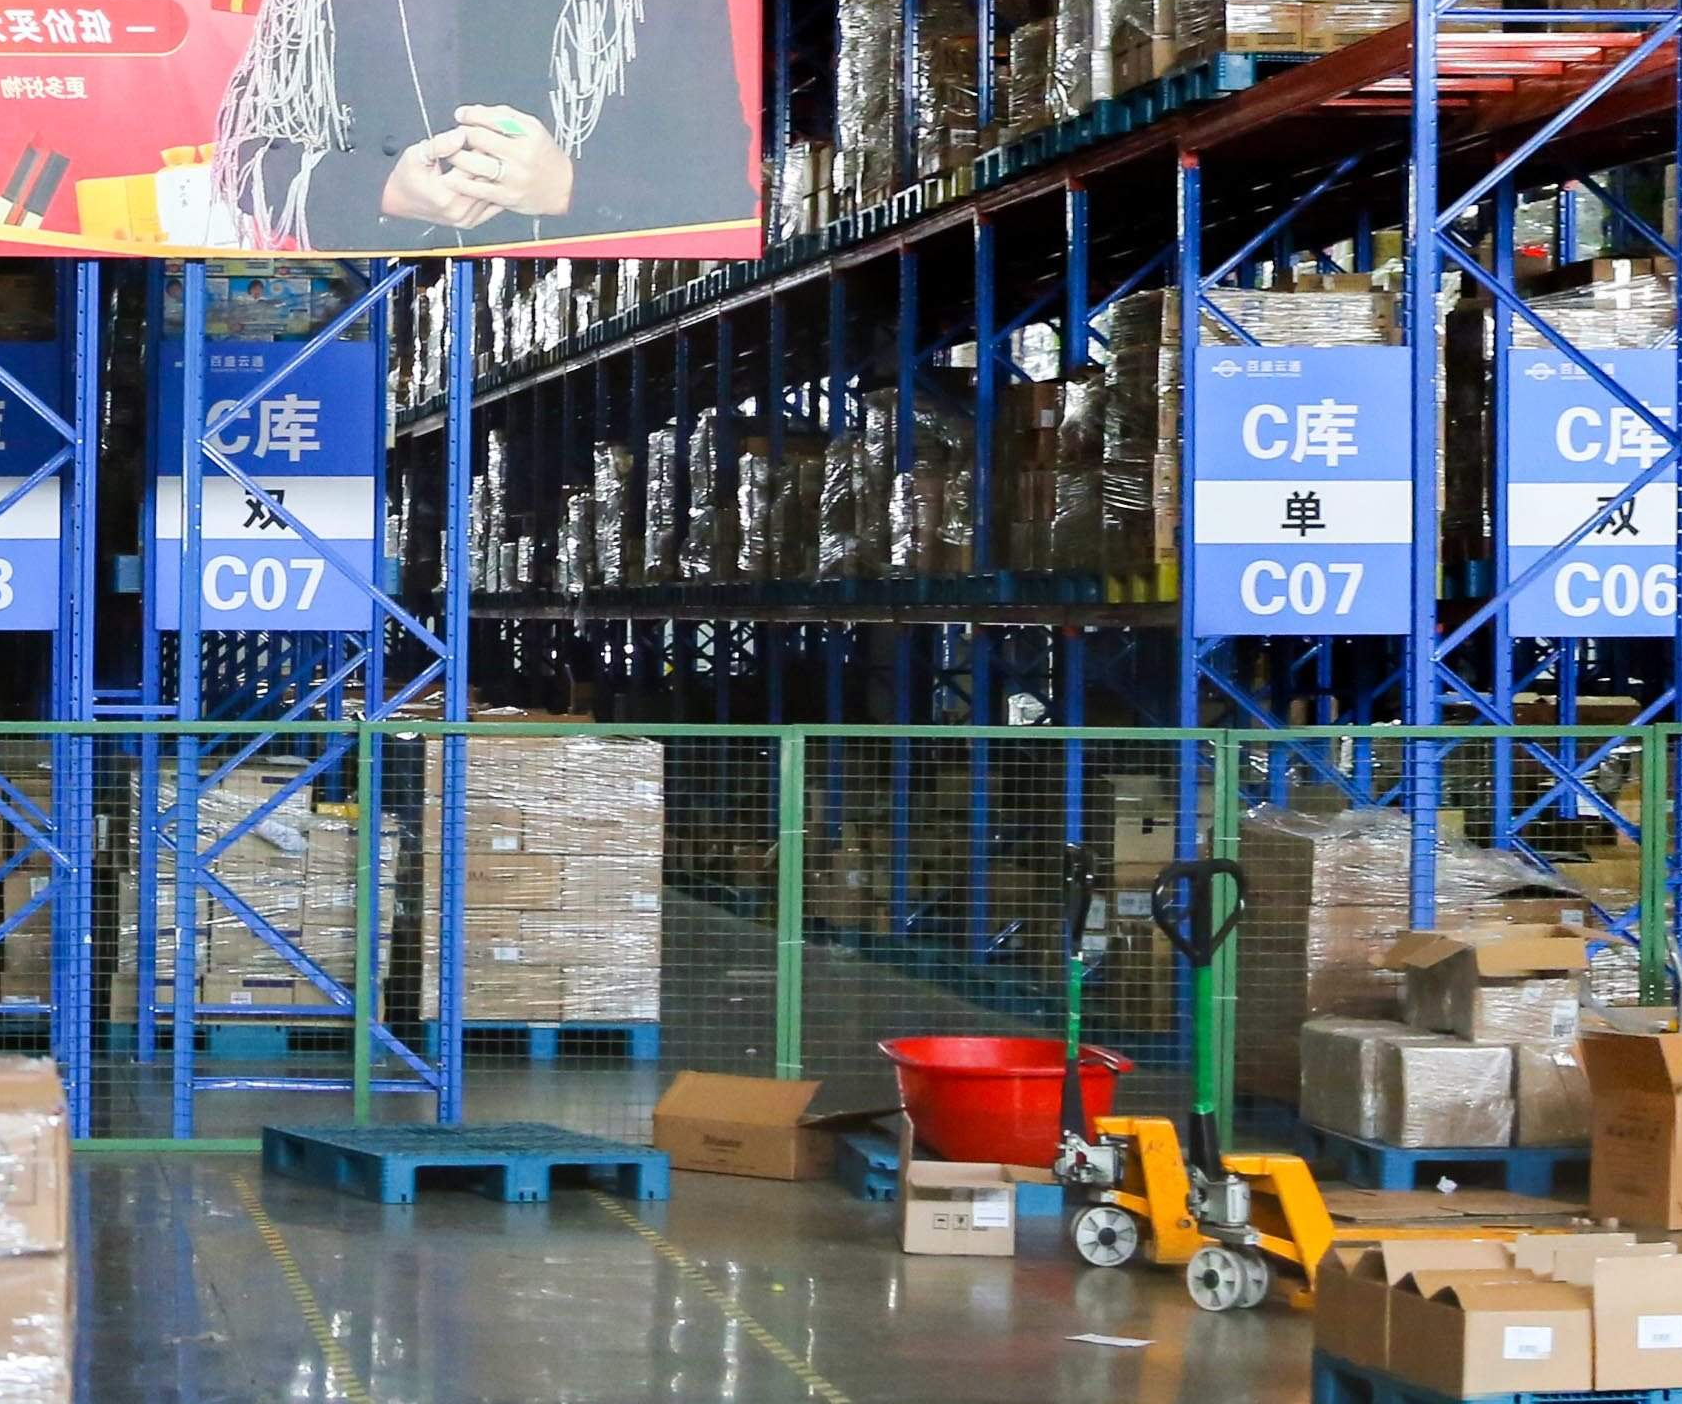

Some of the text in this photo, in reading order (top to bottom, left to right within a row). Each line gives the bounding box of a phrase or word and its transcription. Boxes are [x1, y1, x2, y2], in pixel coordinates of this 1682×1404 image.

[211, 356, 264, 368] 百盛云通
[206, 393, 320, 462] C库
[1242, 398, 1358, 467] C库
[1556, 400, 1672, 469] C库
[243, 490, 289, 530] 双
[1281, 491, 1326, 538] 单
[1596, 496, 1639, 536] 双
[202, 555, 326, 611] C07
[1240, 560, 1364, 616] C07
[1554, 562, 1678, 617] C06
